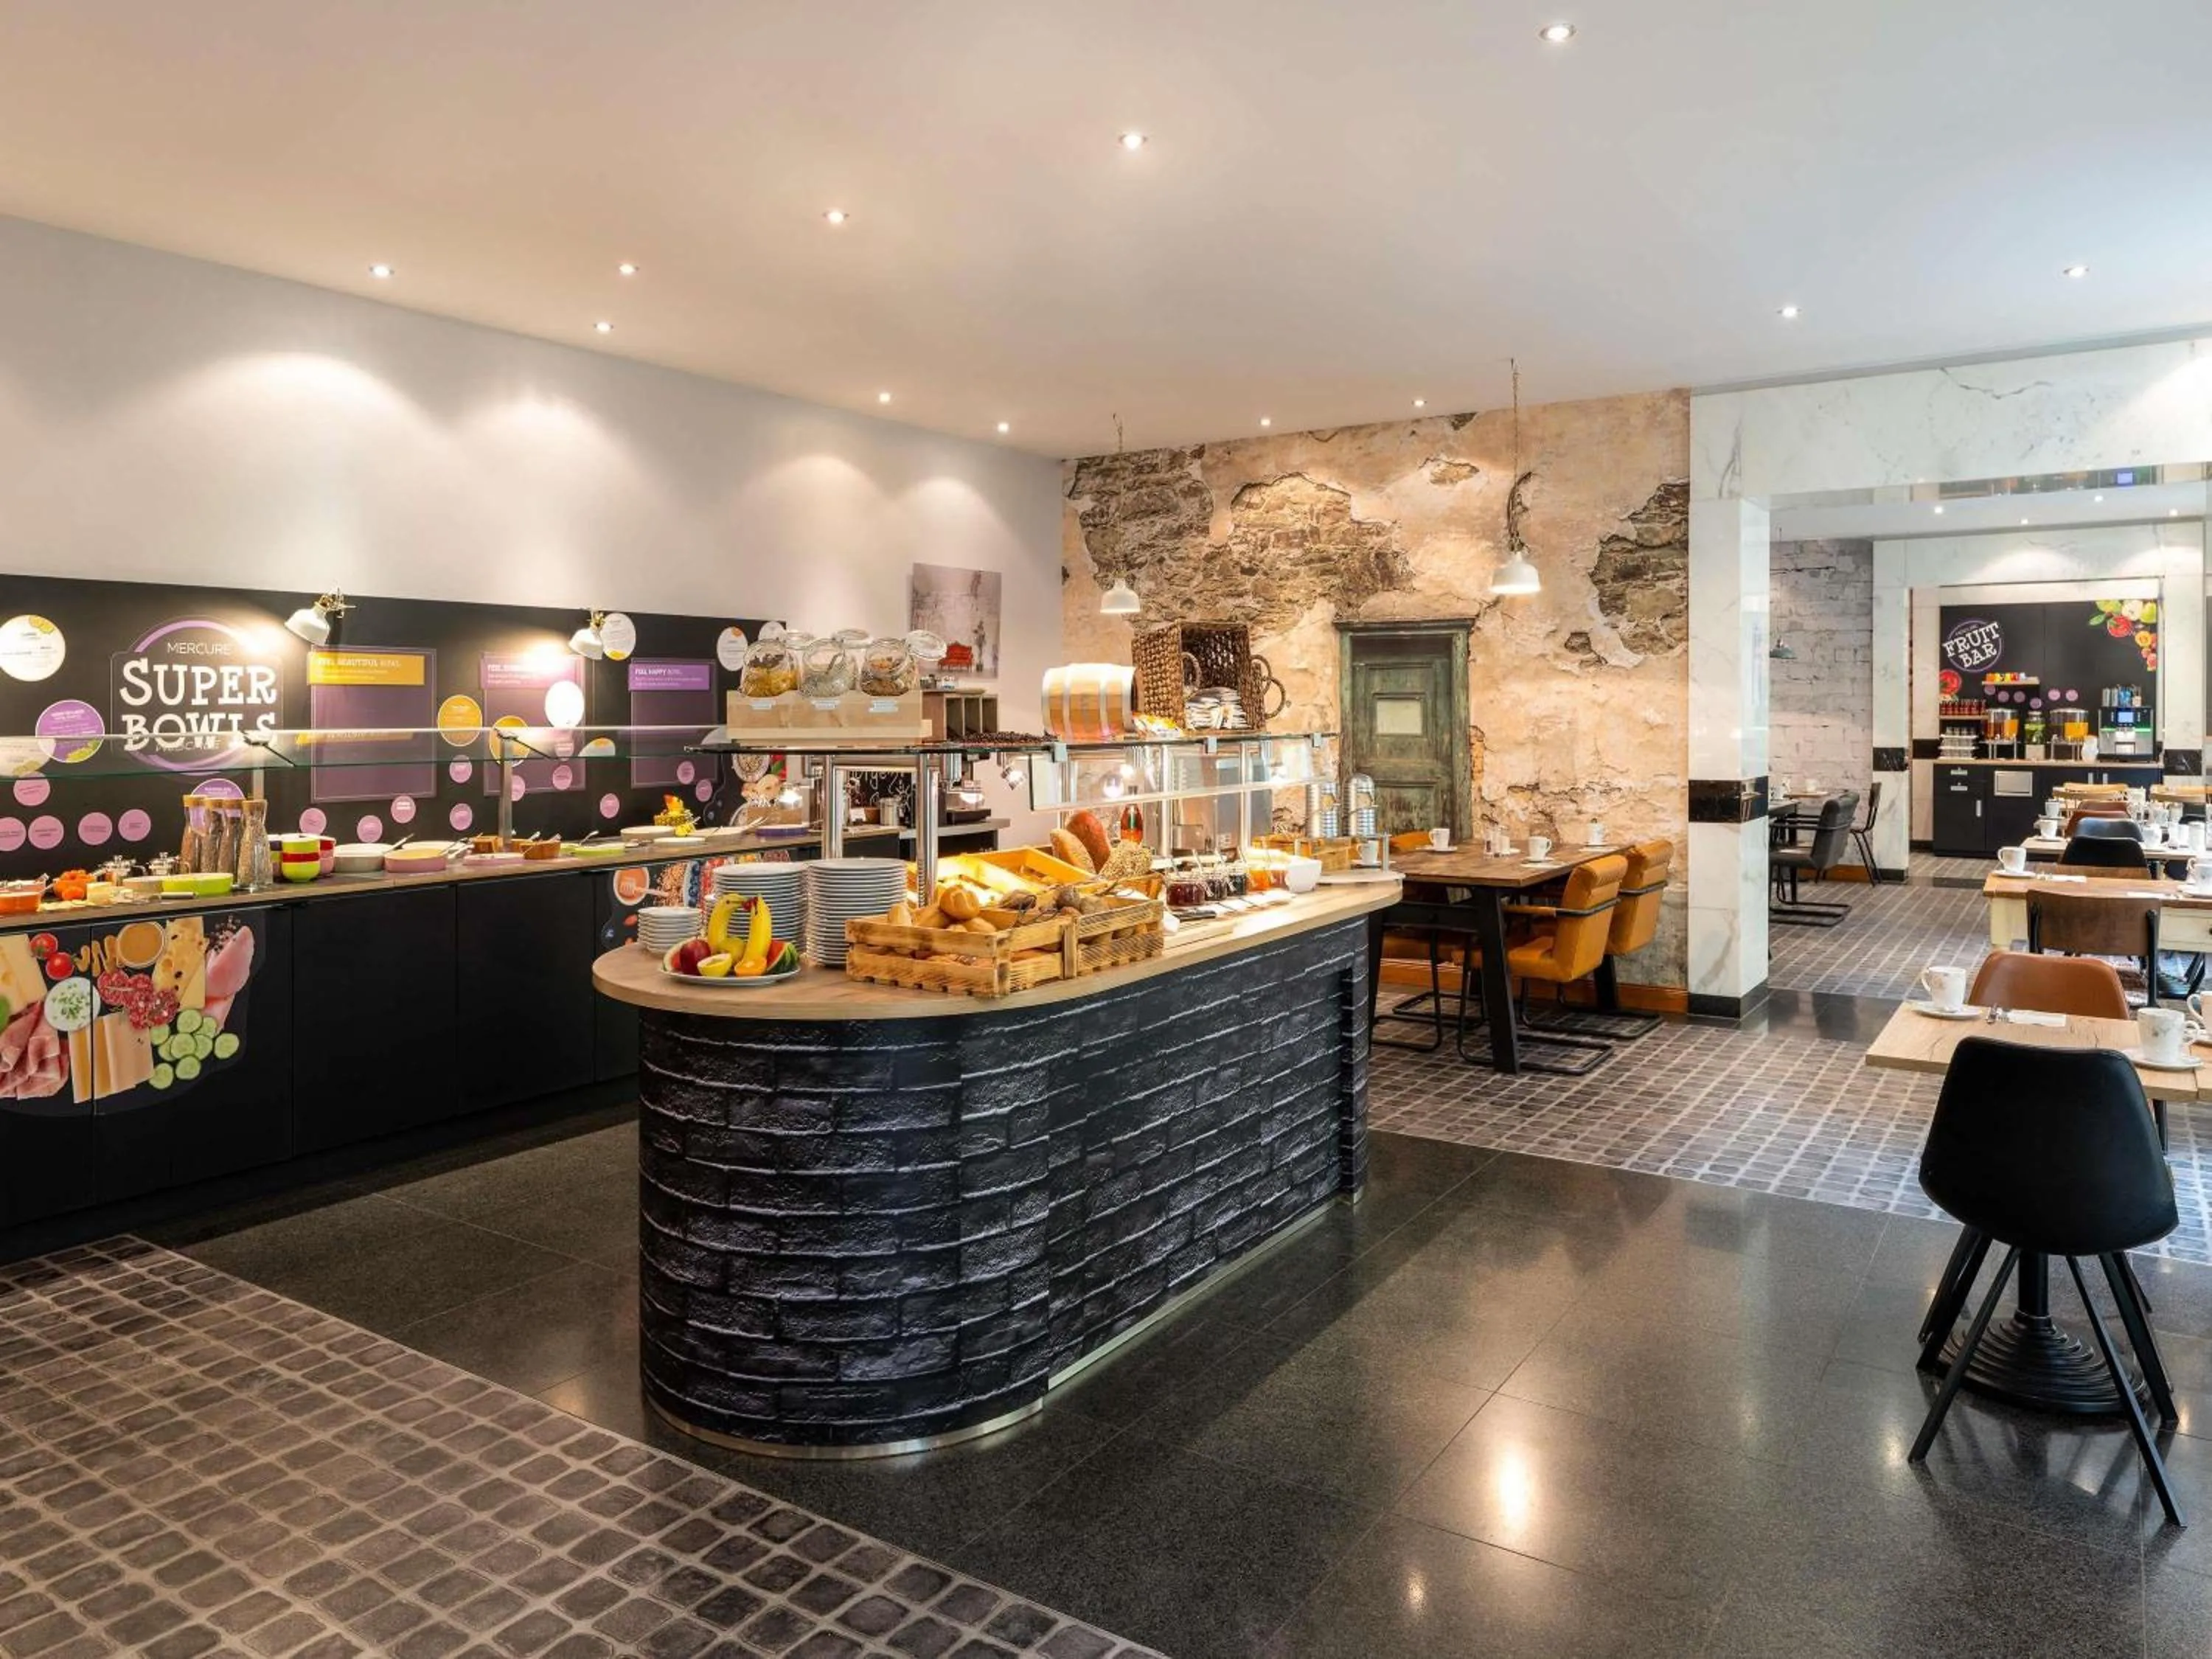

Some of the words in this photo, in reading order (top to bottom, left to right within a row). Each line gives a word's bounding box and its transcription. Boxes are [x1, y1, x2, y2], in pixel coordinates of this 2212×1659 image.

[167, 642, 232, 655] MERCURE
[1941, 622, 2000, 658] FRUIT
[1958, 643, 1997, 667] BAR
[119, 658, 277, 706] SUPER
